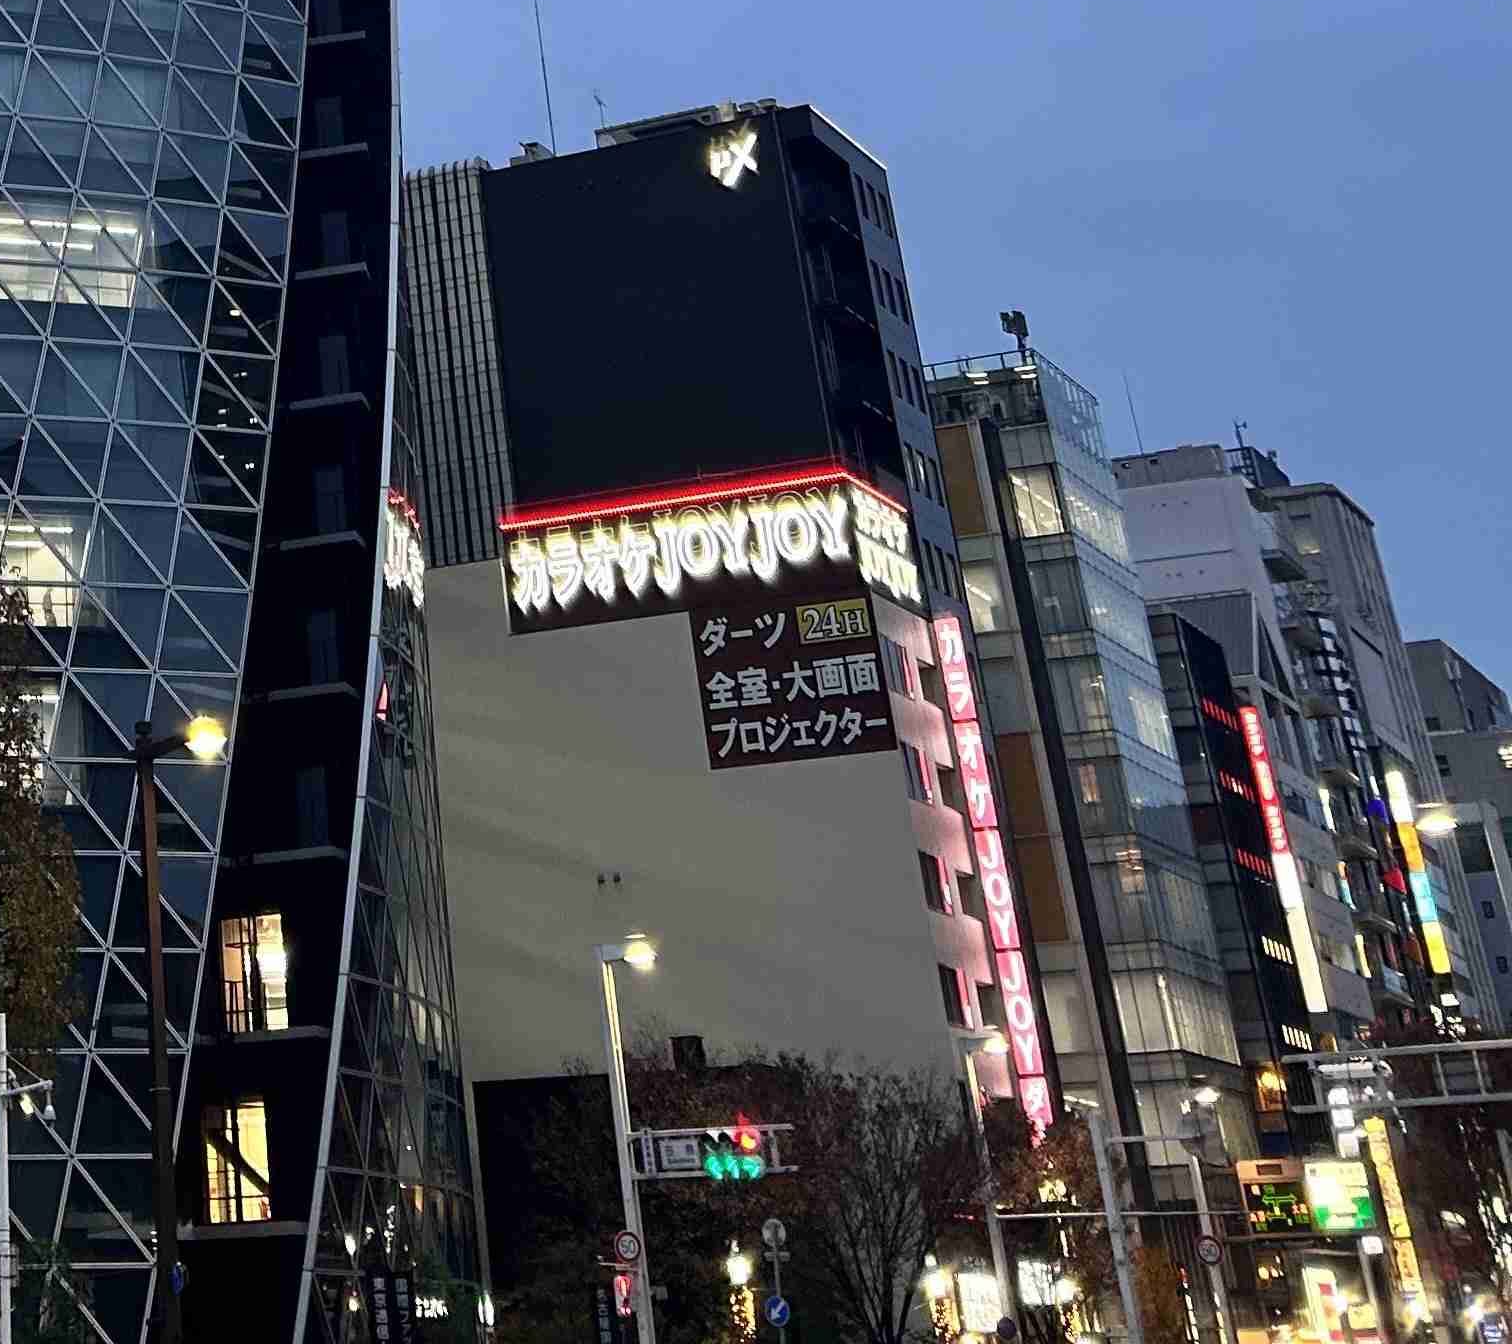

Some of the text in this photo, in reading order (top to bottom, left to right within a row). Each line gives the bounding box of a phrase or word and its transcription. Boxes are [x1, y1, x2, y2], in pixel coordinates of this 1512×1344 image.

[699, 606, 866, 657] ダーツ 24H
[711, 707, 888, 758] プロジェクター
